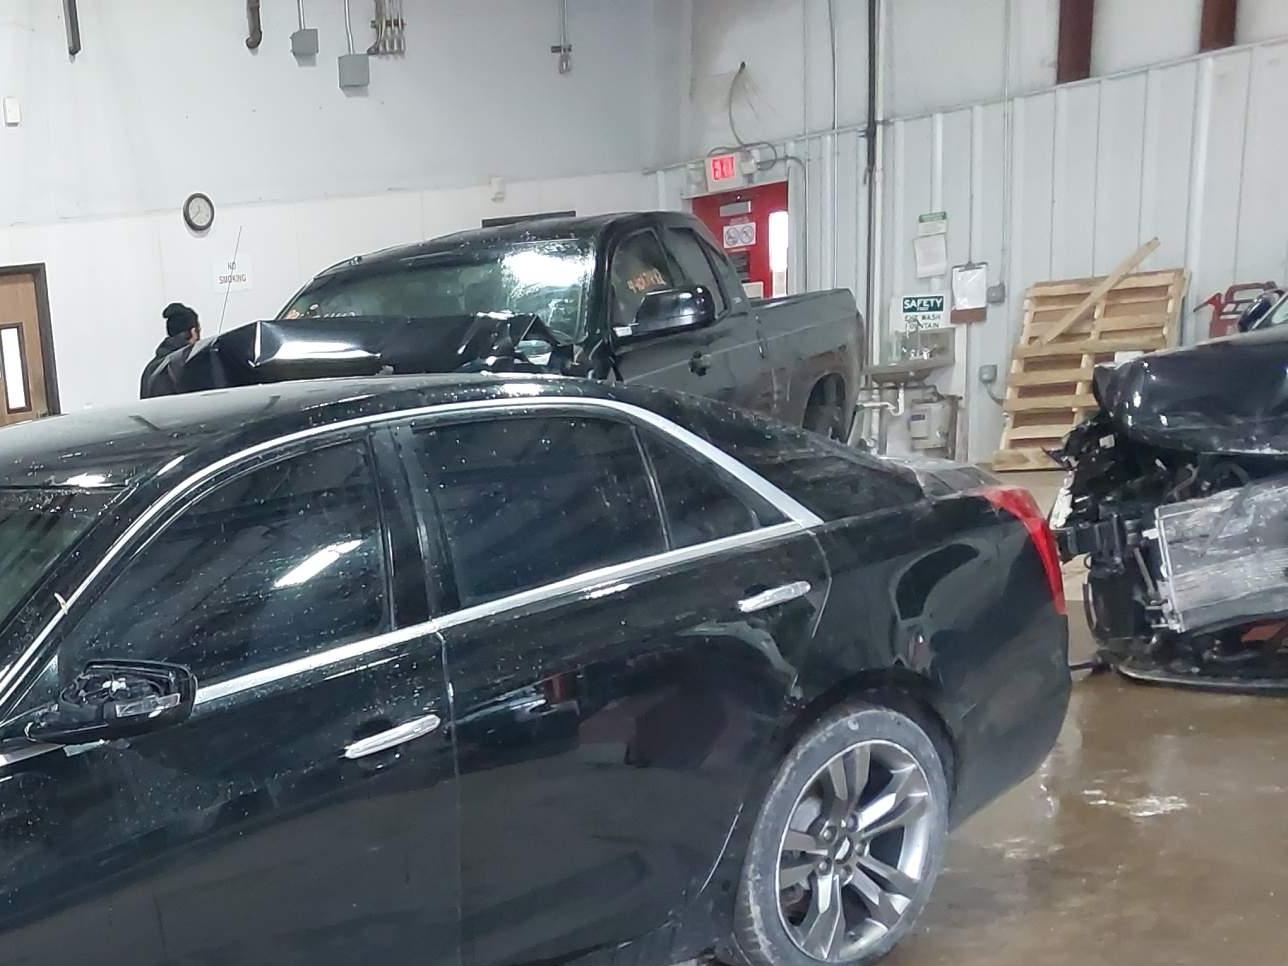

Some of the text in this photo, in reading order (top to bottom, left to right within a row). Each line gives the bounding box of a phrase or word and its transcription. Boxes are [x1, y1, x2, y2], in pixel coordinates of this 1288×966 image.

[228, 261, 237, 270] NO
[219, 273, 247, 284] SMOKING
[903, 298, 943, 309] SAFETY
